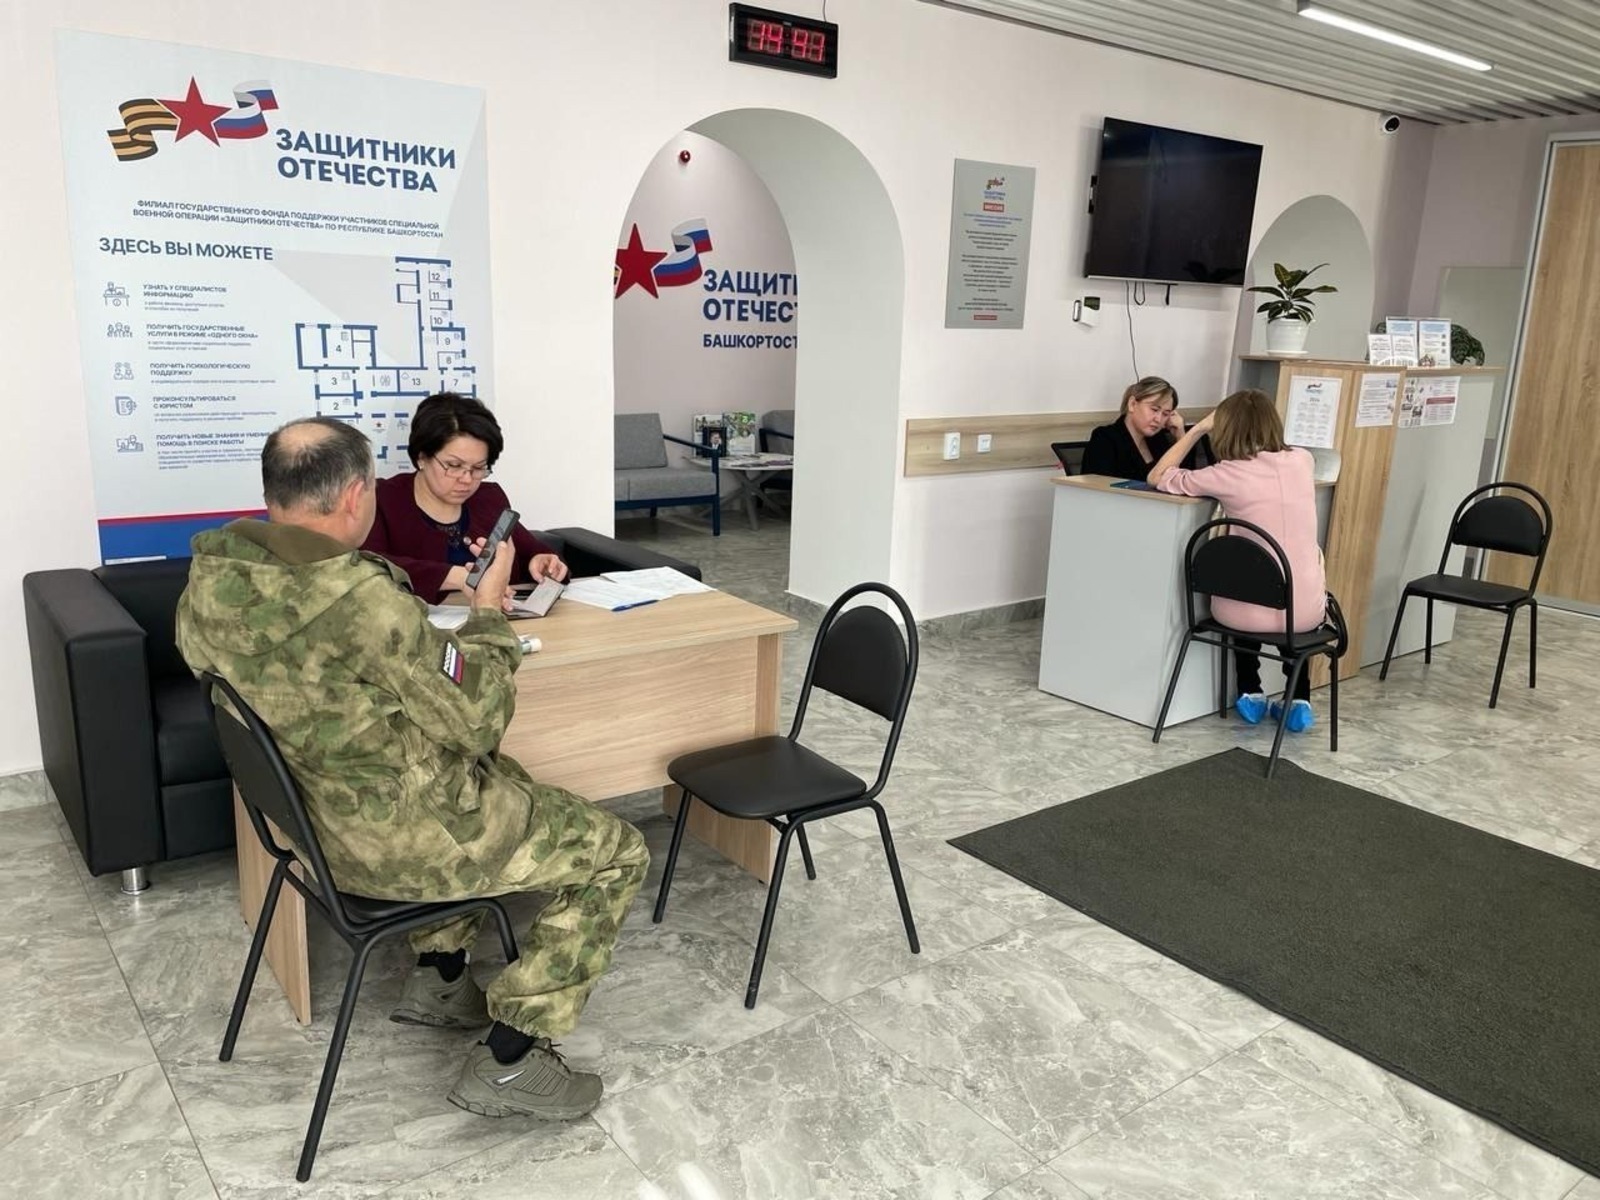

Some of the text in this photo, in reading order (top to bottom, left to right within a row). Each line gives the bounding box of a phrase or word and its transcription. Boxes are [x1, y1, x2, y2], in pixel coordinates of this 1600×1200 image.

[275, 128, 456, 169] ЗАЩИТНИКИ
[277, 156, 438, 192] ОТЕЧЕСТВА
[137, 199, 439, 230] ФИЛИАЛ ГОСУДАРСТВЕННОГО ФОНДА ПОДДЕРЖКИ УЧАСТНИКОВ СПЕЦИАЛЬНОЙ
[133, 208, 443, 239] ВОЕННОЙ ОПЕРАЦИИ «ЗАЩИТНИКИ ОТЕЧЕСТВА» ПО РЕСПУБЛИКЕ БАШКОРТОСТАН
[98, 237, 274, 261] ЗДЕСЬ ВЫ МОЖЕТЕ
[431, 273, 440, 281] 12
[703, 268, 797, 297] ЗАЩИТ
[143, 284, 168, 292] УЗНАТЬ
[174, 285, 227, 293] СПЕЦИАЛИСТОВ
[143, 291, 194, 299] ИНФОРМАЦИЮ
[432, 292, 440, 300] 11
[703, 299, 797, 324] ОТЕЧЕС
[433, 317, 443, 325] 10
[146, 323, 245, 332] ПОЛУЧИТЬ ГОСУДАРСТВЕННЫЕ
[445, 337, 451, 346] 9
[335, 344, 342, 352] 4
[150, 362, 185, 370] ПОЛУЧИТЬ
[150, 369, 193, 377] ПОДДЕРЖКУ
[331, 377, 338, 386] 3
[411, 378, 421, 386] 13
[333, 402, 339, 411] 2
[192, 432, 214, 440] НОВЫЕ
[157, 440, 188, 448] ПОМОЩЬ
[193, 439, 219, 447] ПОИСКЕ
[219, 438, 244, 446] РАБОТЫ
